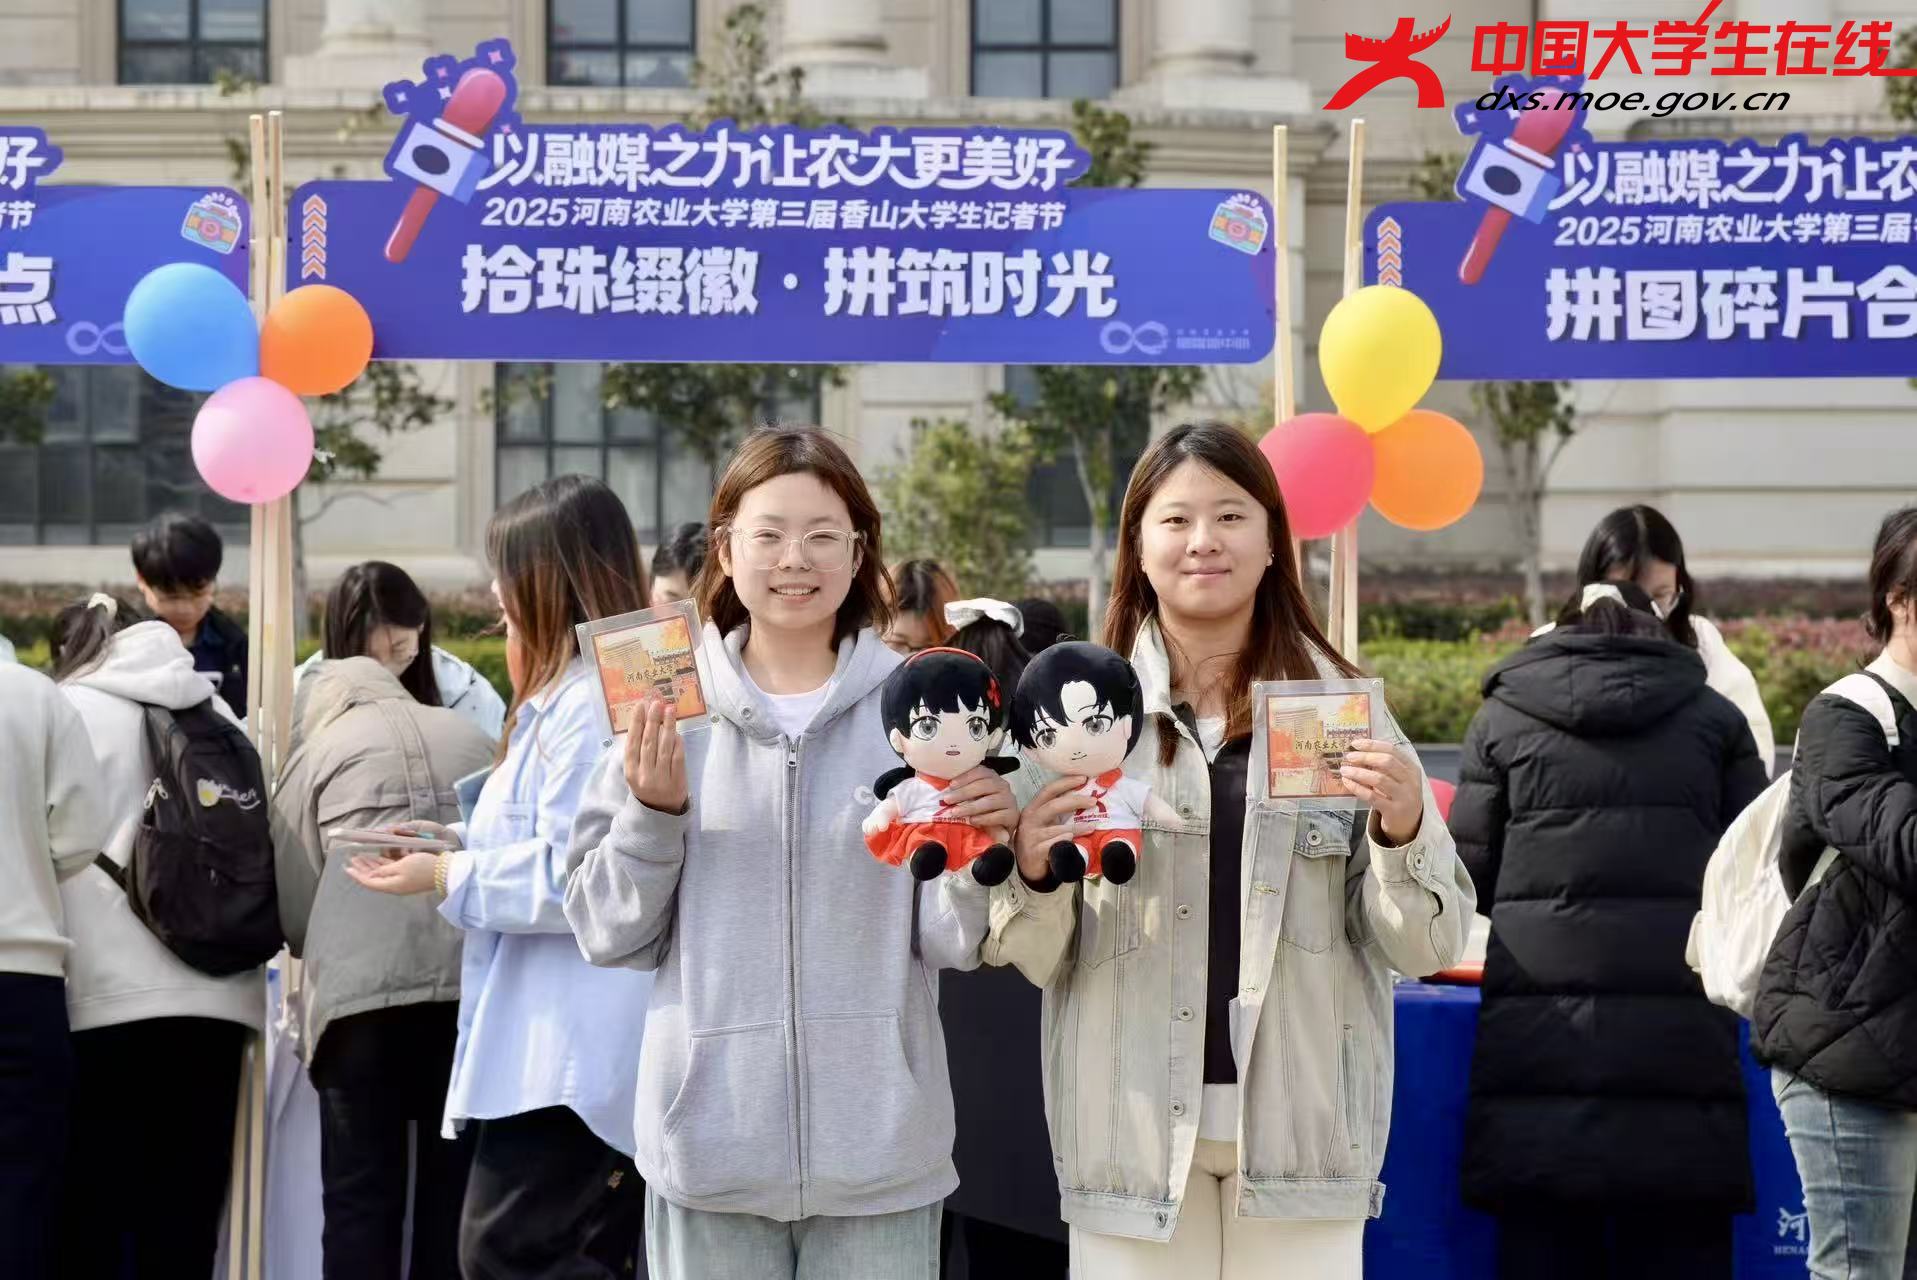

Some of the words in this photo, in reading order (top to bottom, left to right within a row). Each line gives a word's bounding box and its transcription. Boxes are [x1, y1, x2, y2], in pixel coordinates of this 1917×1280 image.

[476, 127, 1076, 192] 以融媒之力让农大更美好
[0, 199, 36, 230] 节
[1554, 212, 1917, 246] 2025河南农业大学第三届
[0, 252, 57, 325] 点
[1545, 266, 1917, 341] 拼图碎片合
